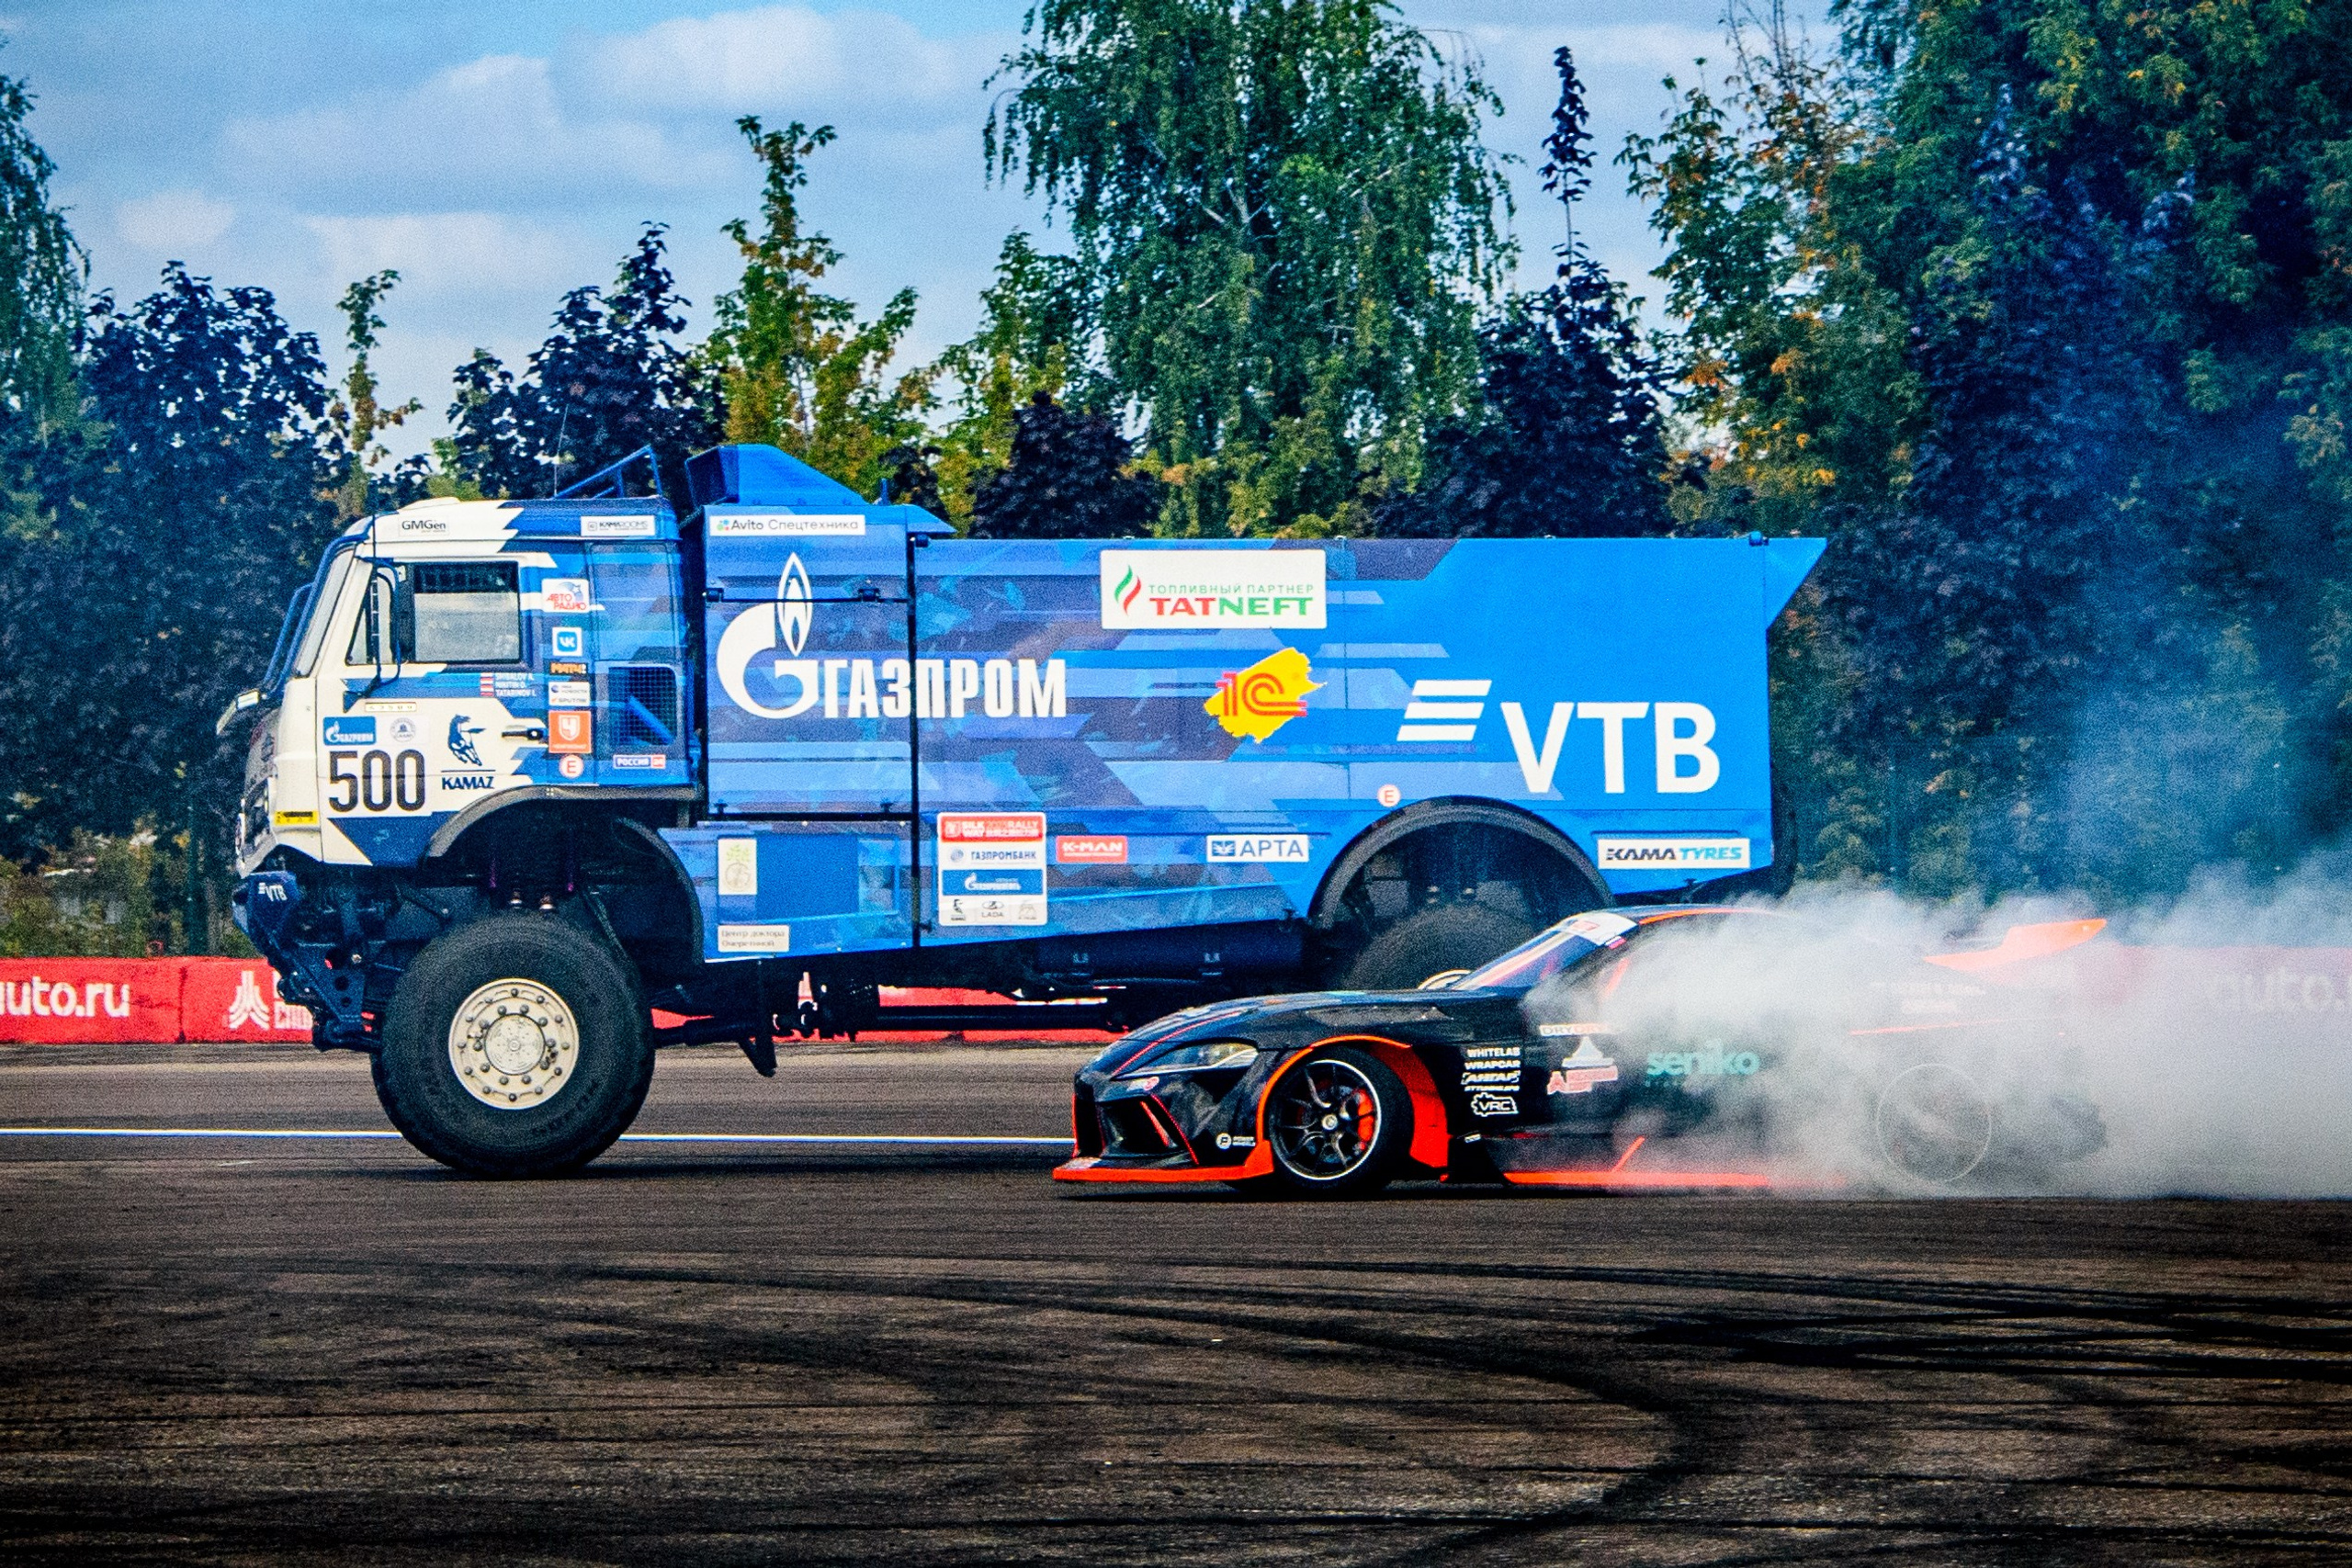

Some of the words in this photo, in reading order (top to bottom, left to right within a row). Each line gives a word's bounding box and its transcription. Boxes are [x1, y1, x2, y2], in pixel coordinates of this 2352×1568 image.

[730, 519, 764, 531] Avito
[767, 519, 858, 532] Спецтехника
[1149, 584, 1241, 594] ТОПЛИВНЫЙ
[1247, 584, 1314, 593] ПАРТНЕР
[1149, 597, 1314, 616] TATNEFT
[824, 659, 1067, 718] ГАЗПРОМ
[1500, 702, 1721, 794] VTB
[328, 749, 426, 813] 500
[441, 775, 494, 790] KAMAZ
[1062, 841, 1124, 852] K-MAN
[1605, 847, 1677, 861] KAMA
[1679, 846, 1743, 861] TYRES
[970, 851, 1036, 861] ГАЗПРОМБАНК
[0, 976, 130, 1017] uto.ru
[1467, 1047, 1521, 1057] WHITELAB
[1464, 1059, 1521, 1070] WRAPCAR
[1478, 1100, 1511, 1111] VRC
